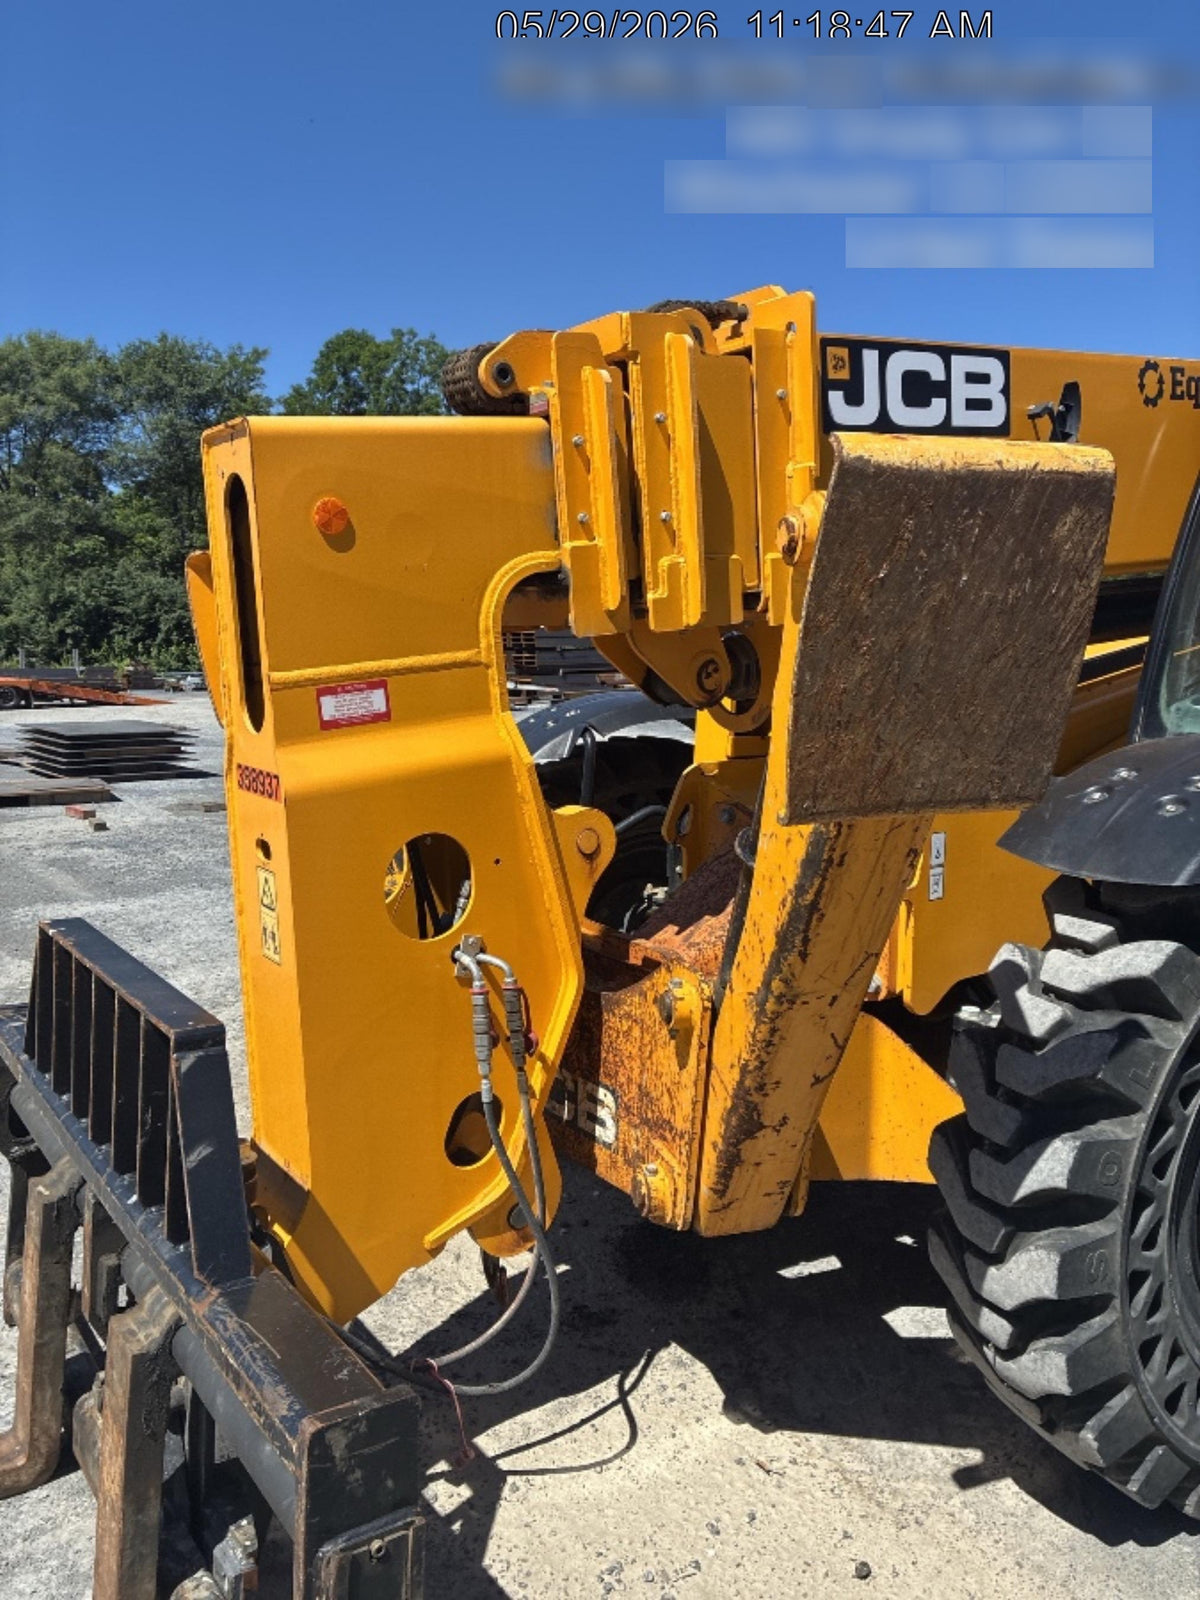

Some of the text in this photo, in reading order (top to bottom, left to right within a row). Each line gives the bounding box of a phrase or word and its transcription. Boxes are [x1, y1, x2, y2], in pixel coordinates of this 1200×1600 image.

[828, 348, 1008, 428] JCB
[1169, 365, 1200, 410] Eq
[545, 1067, 617, 1145] CB
